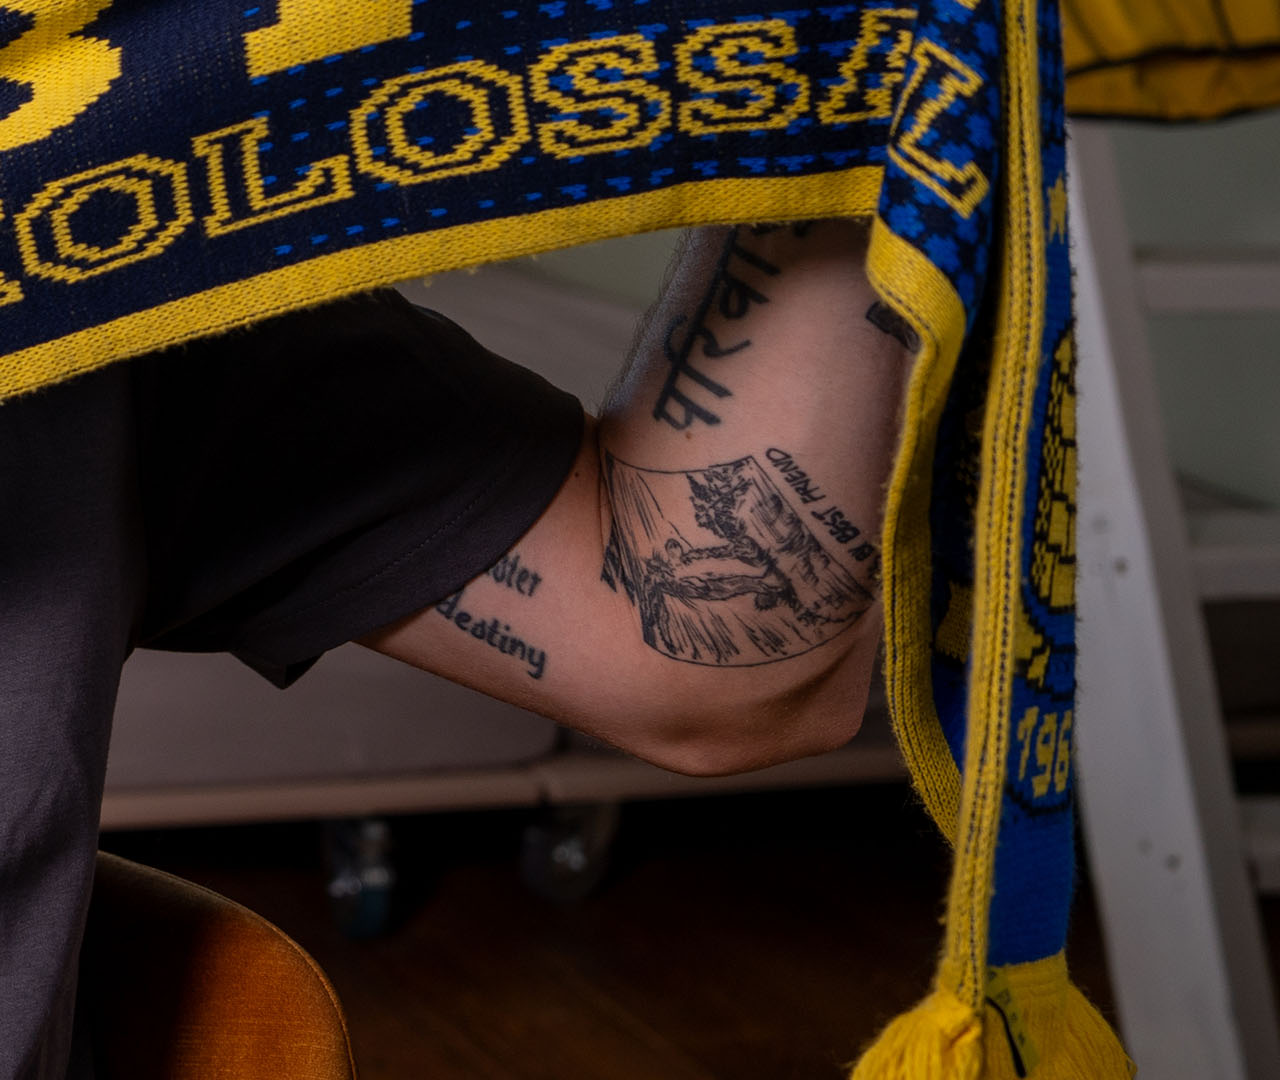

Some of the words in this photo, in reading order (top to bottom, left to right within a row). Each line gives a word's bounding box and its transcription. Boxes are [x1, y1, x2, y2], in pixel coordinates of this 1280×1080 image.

[765, 448, 827, 504] FRIEND
[811, 506, 861, 544] BEST
[435, 588, 546, 679] destiny
